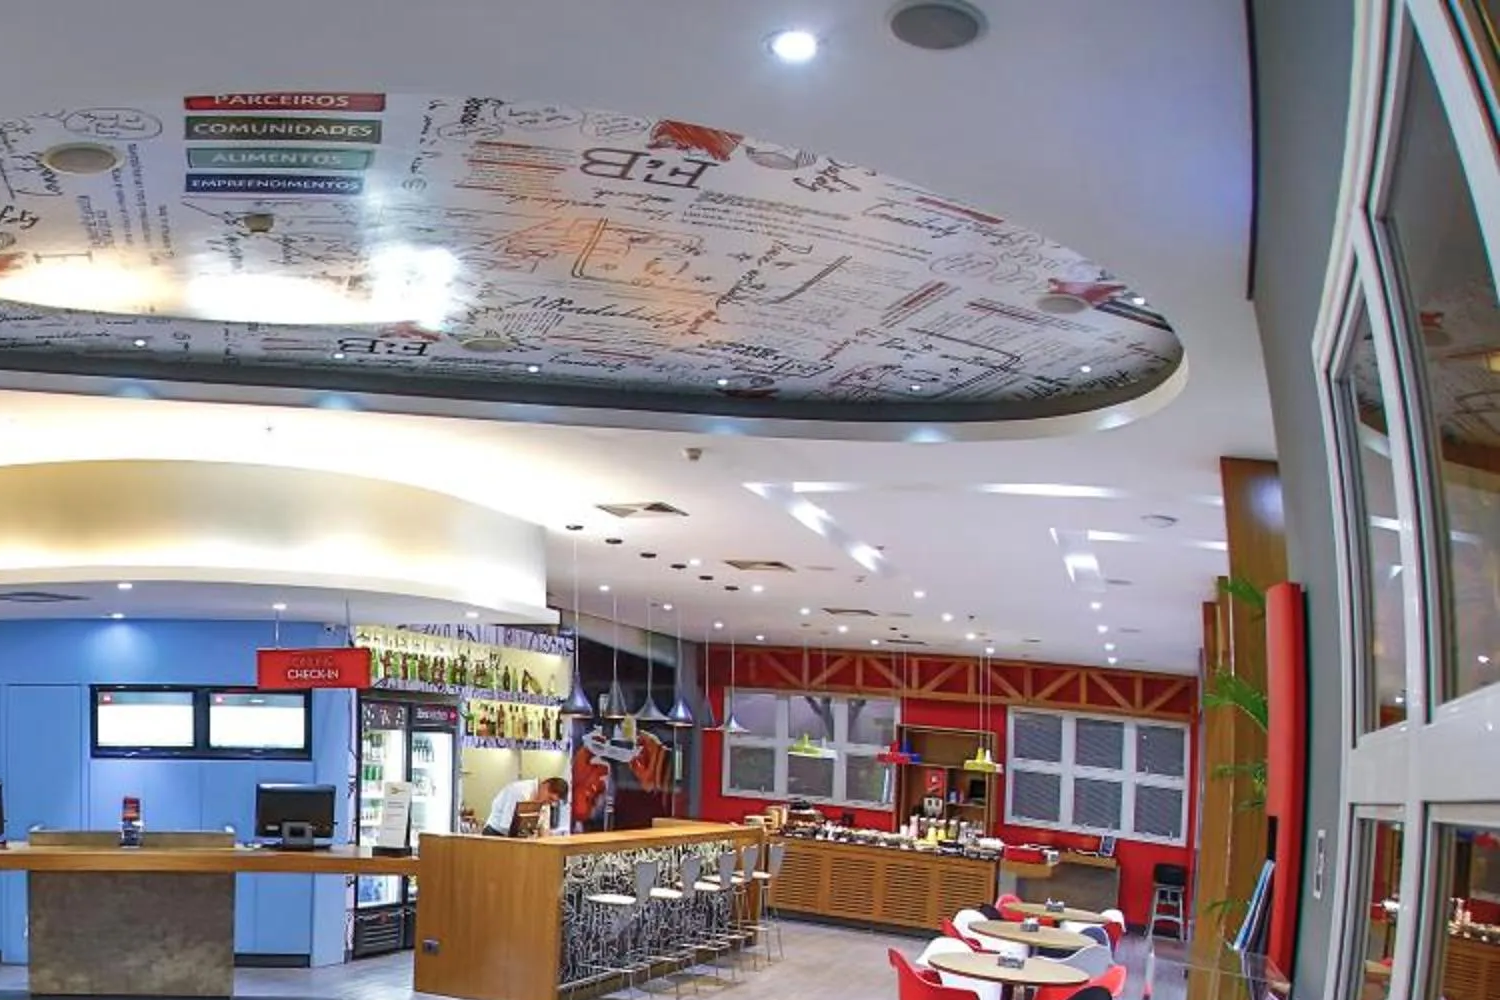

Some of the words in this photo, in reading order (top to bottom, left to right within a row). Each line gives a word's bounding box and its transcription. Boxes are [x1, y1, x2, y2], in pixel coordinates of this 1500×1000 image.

[214, 95, 349, 107] PARCEIROS
[193, 122, 373, 137] COMUNIDADES
[211, 152, 342, 165] ALIMENTOS
[191, 179, 359, 191] EMPREENDIMENTOS
[287, 668, 339, 679] CHECK-IN
